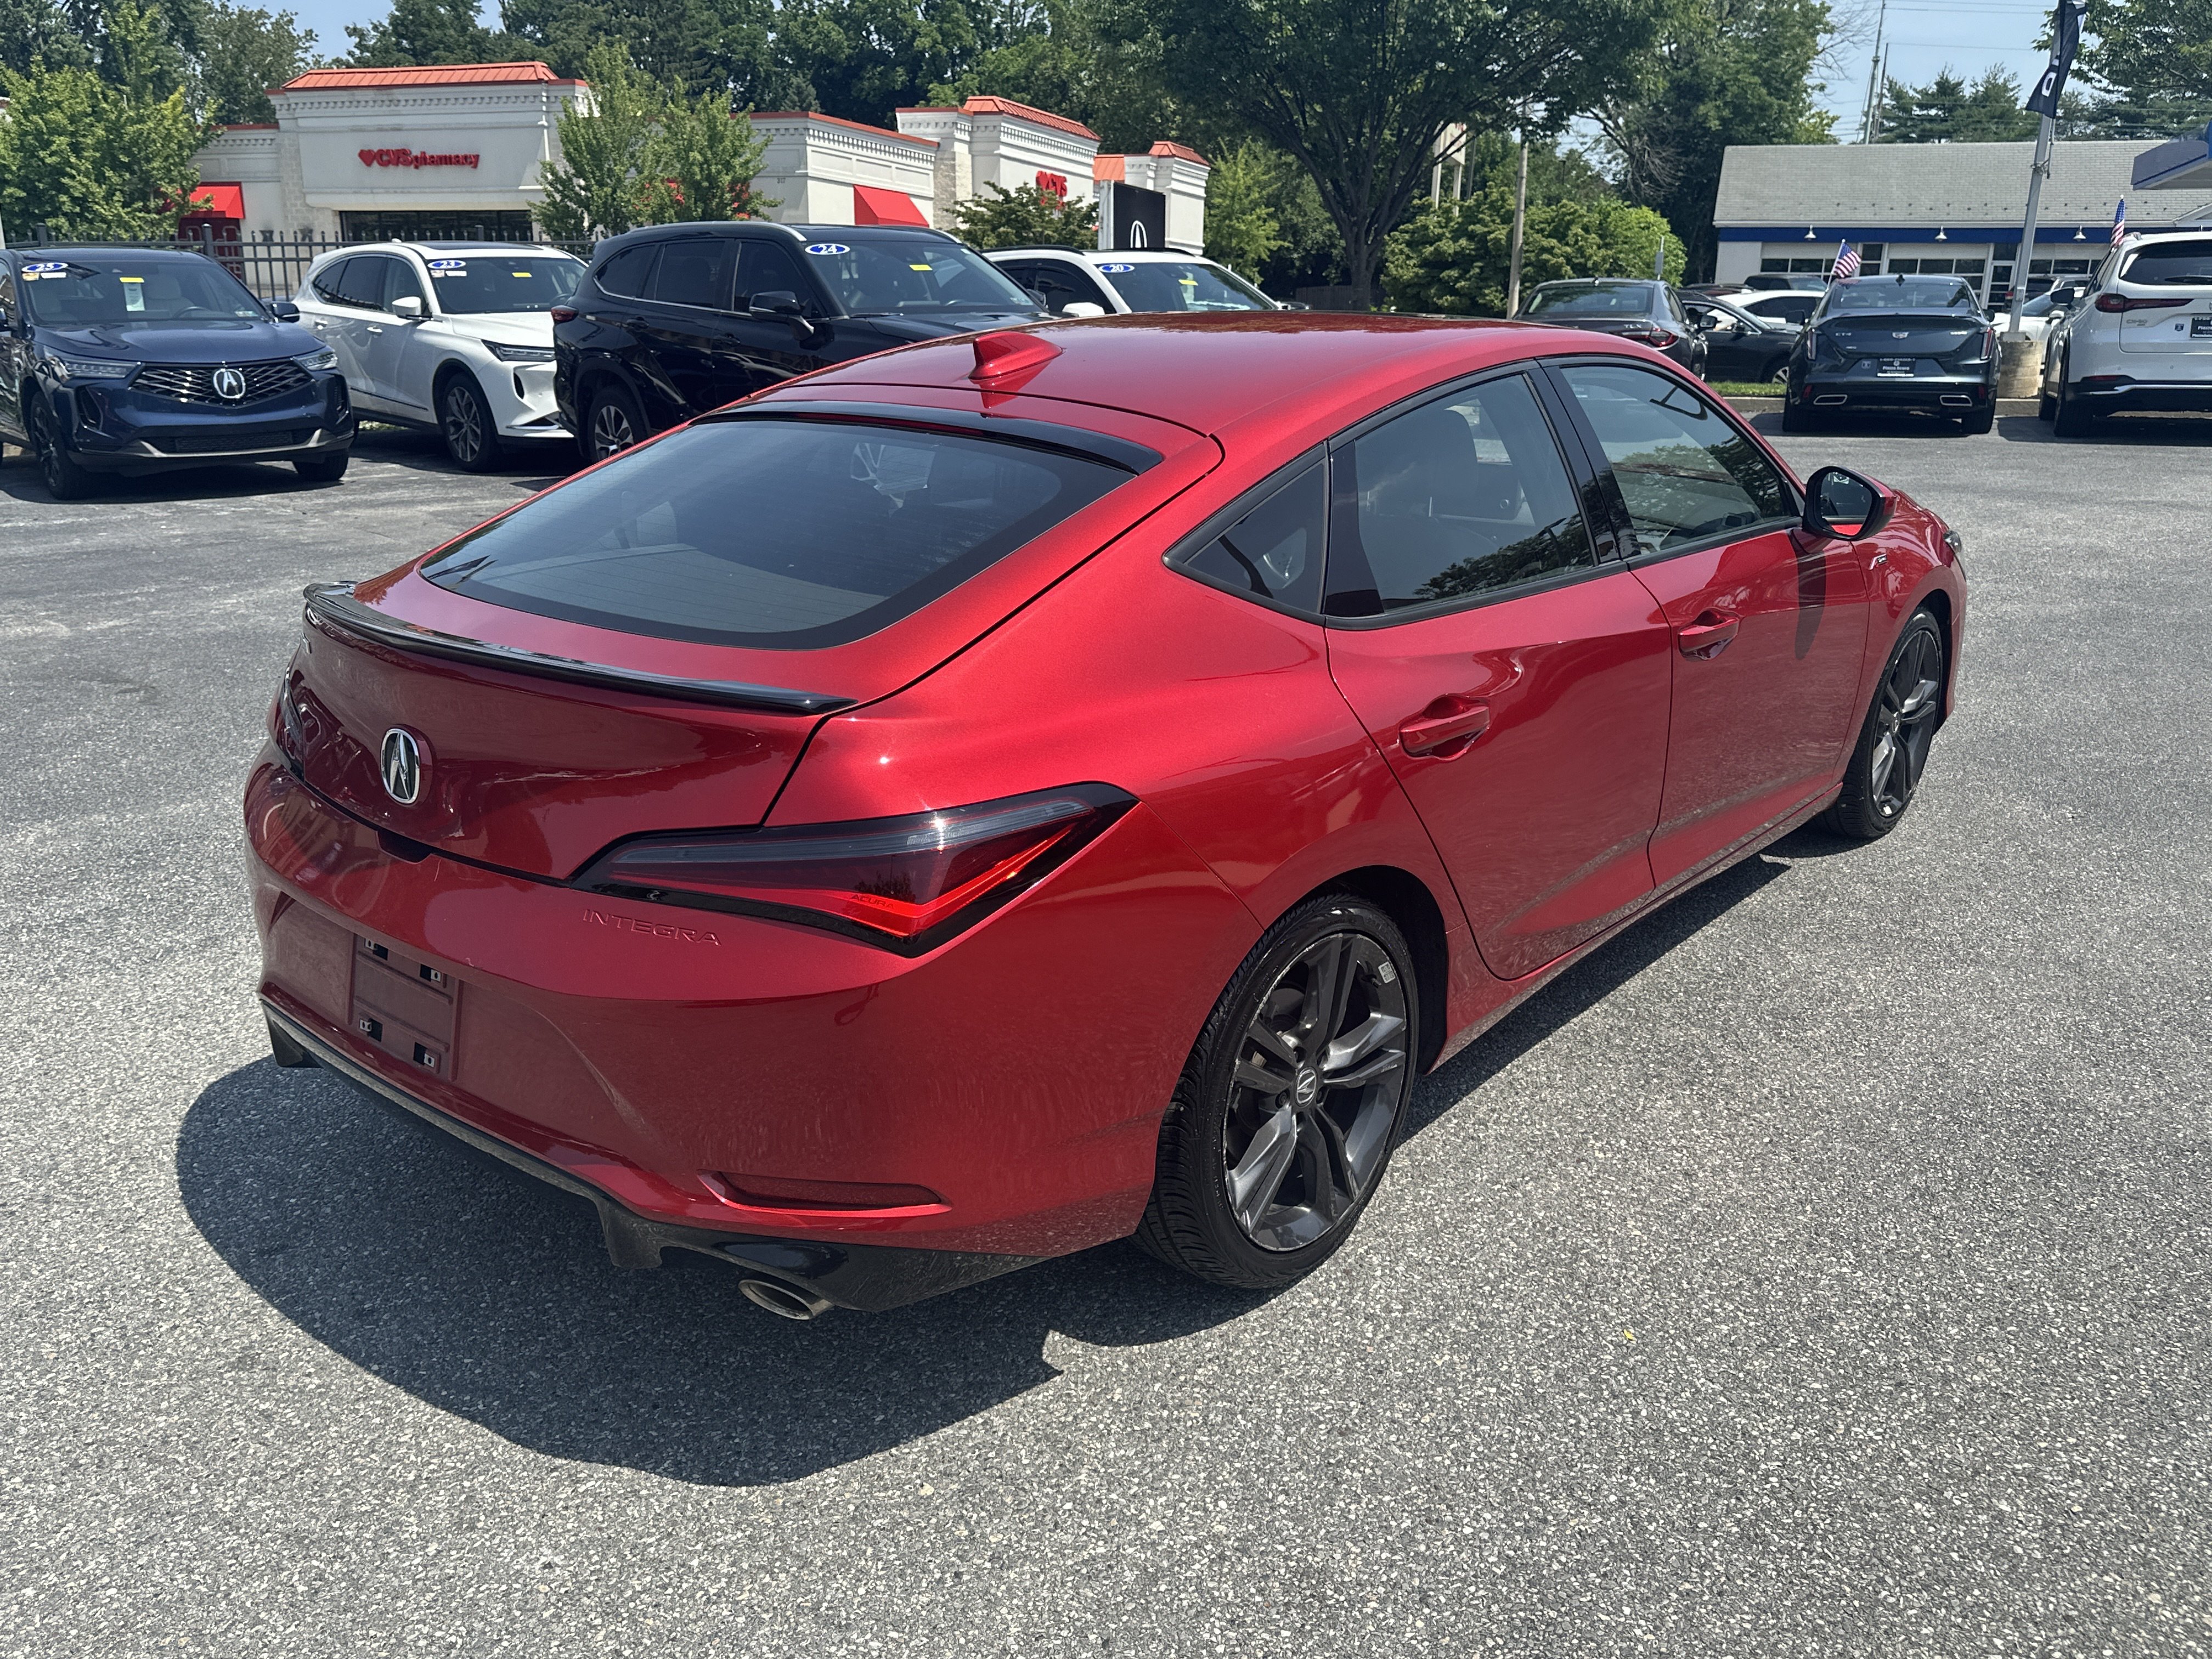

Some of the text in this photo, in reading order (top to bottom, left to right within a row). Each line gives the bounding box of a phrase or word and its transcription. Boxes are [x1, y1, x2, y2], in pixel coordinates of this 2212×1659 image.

[375, 149, 479, 170] CVS pharmacy
[819, 245, 838, 255] 24
[36, 263, 55, 272] 25
[440, 261, 455, 269] 23
[1109, 264, 1124, 273] 20
[851, 894, 895, 909] ACURA
[583, 909, 722, 946] INTEGRA
